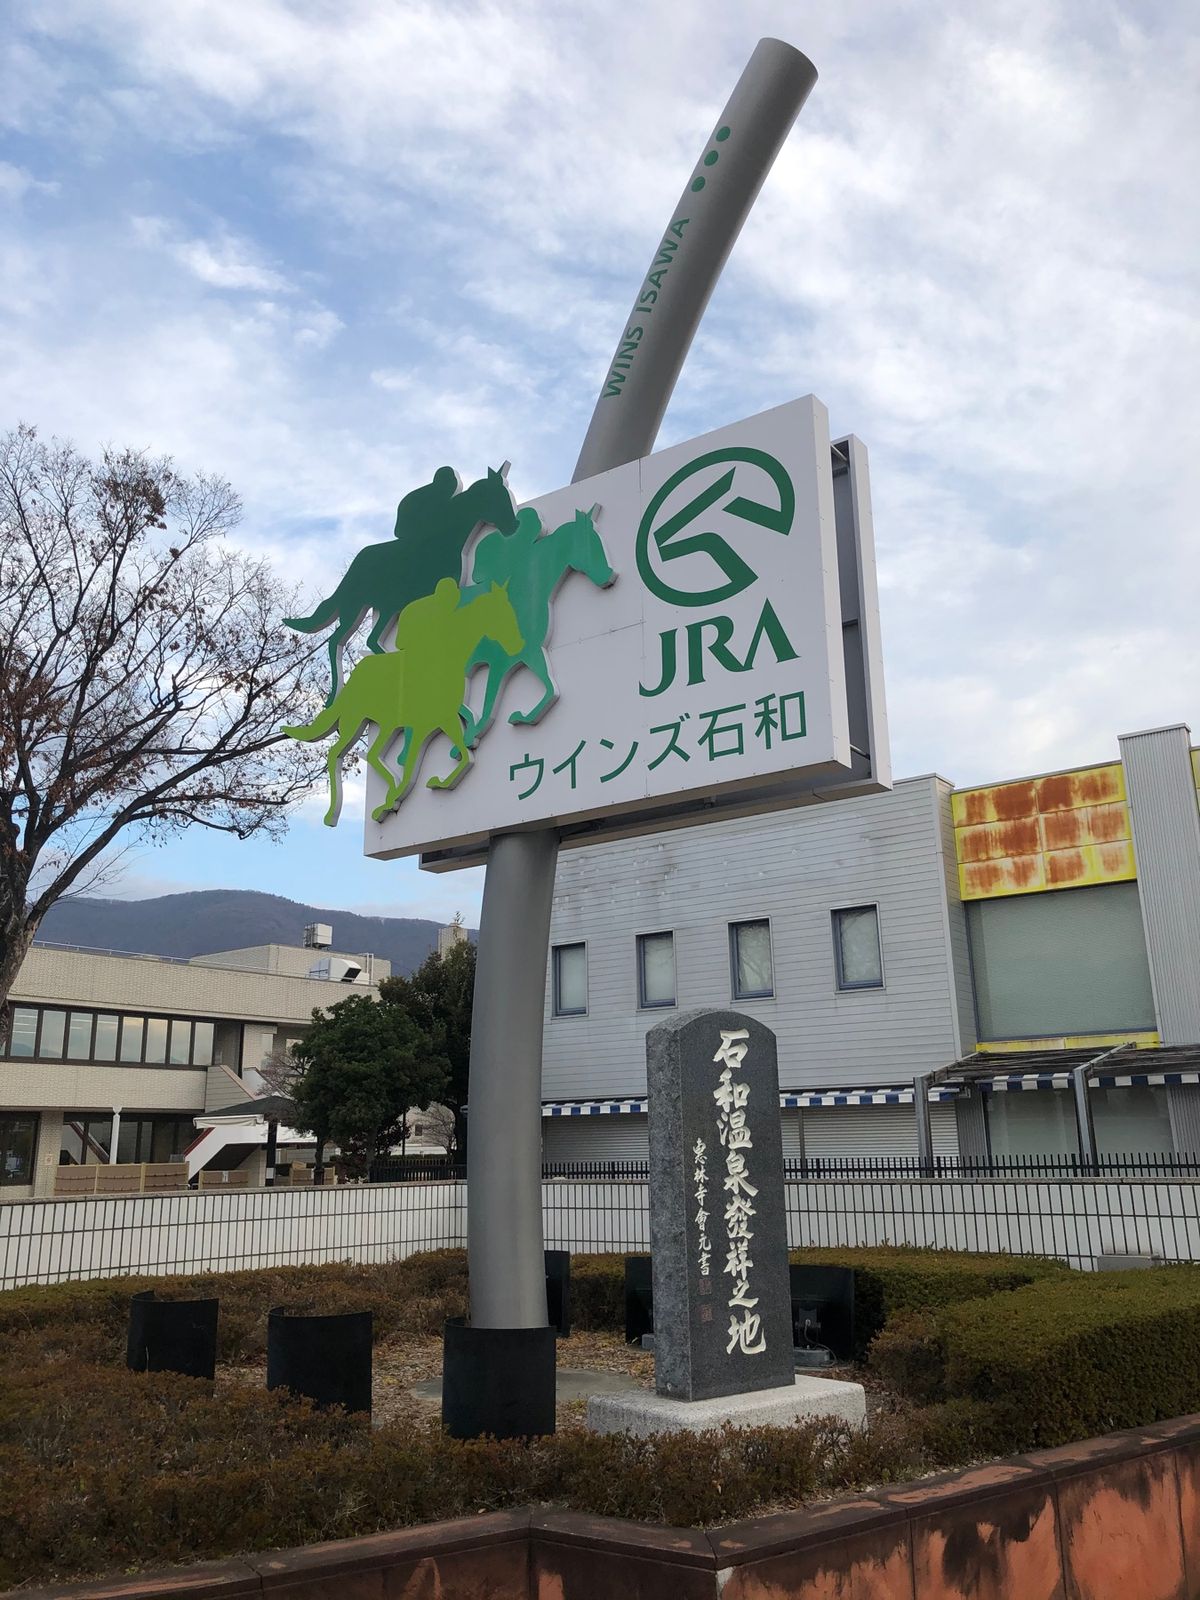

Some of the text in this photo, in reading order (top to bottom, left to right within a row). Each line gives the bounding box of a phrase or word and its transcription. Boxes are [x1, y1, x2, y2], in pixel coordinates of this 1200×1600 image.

[603, 217, 690, 399] WINS ISAWA
[639, 598, 801, 698] JRA
[509, 690, 807, 800] ウインズ石和
